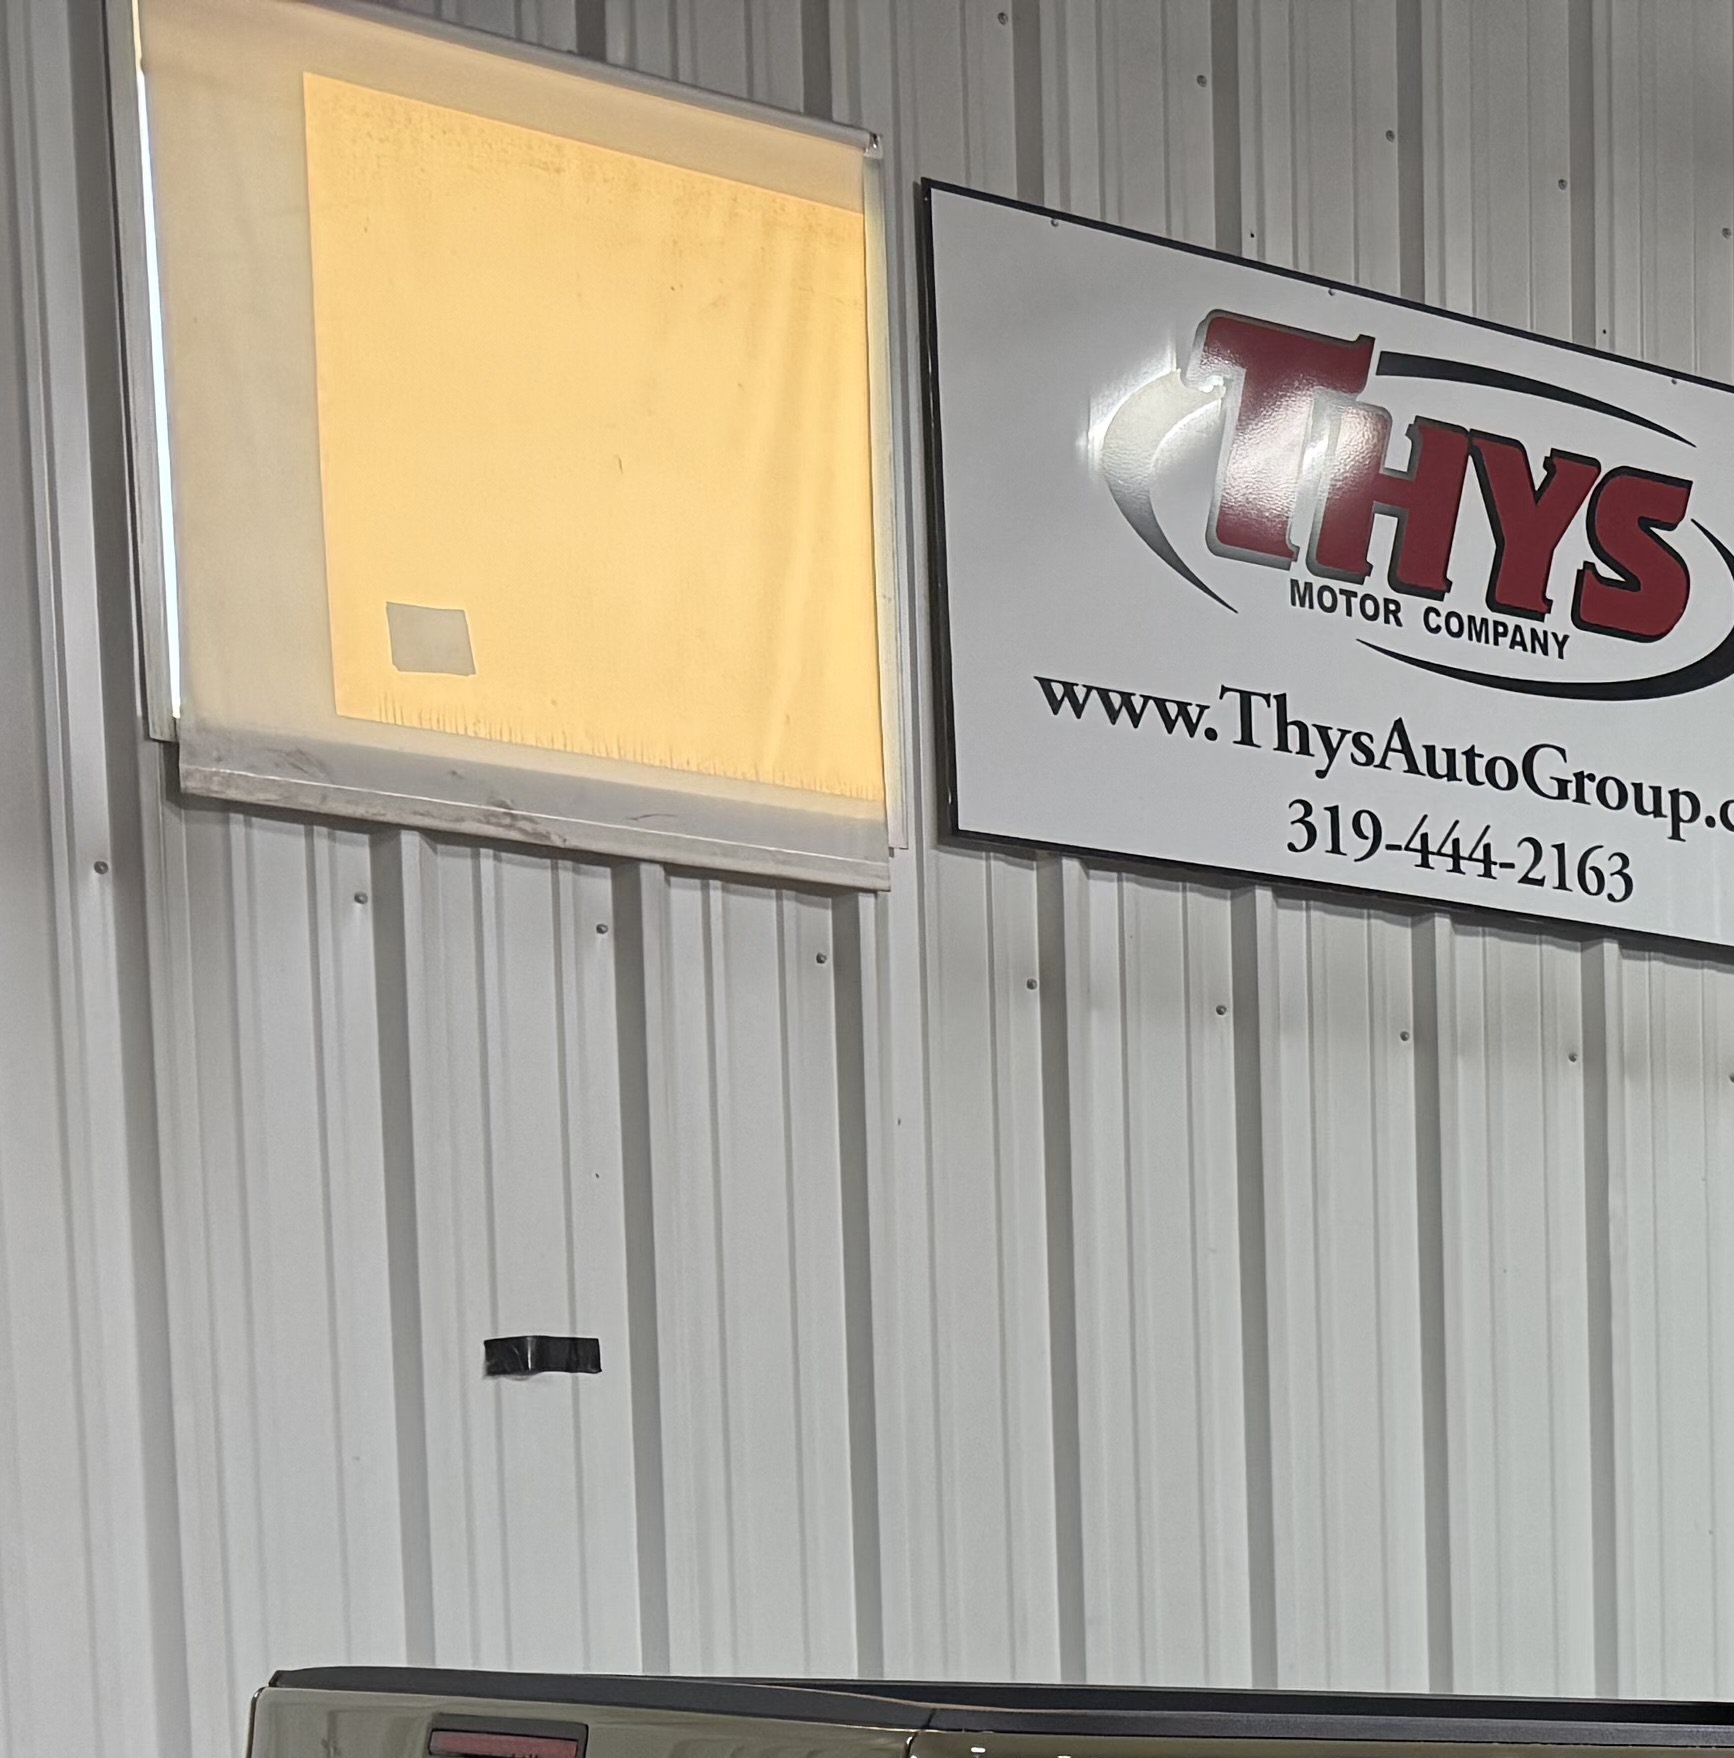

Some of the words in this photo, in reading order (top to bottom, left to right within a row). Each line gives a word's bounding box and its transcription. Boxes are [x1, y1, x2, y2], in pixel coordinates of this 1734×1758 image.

[1190, 308, 1694, 644] THYS
[1289, 578, 1403, 628] MOTOR
[1423, 606, 1572, 661] COMPANY
[1286, 798, 1635, 904] 319-444-2163
